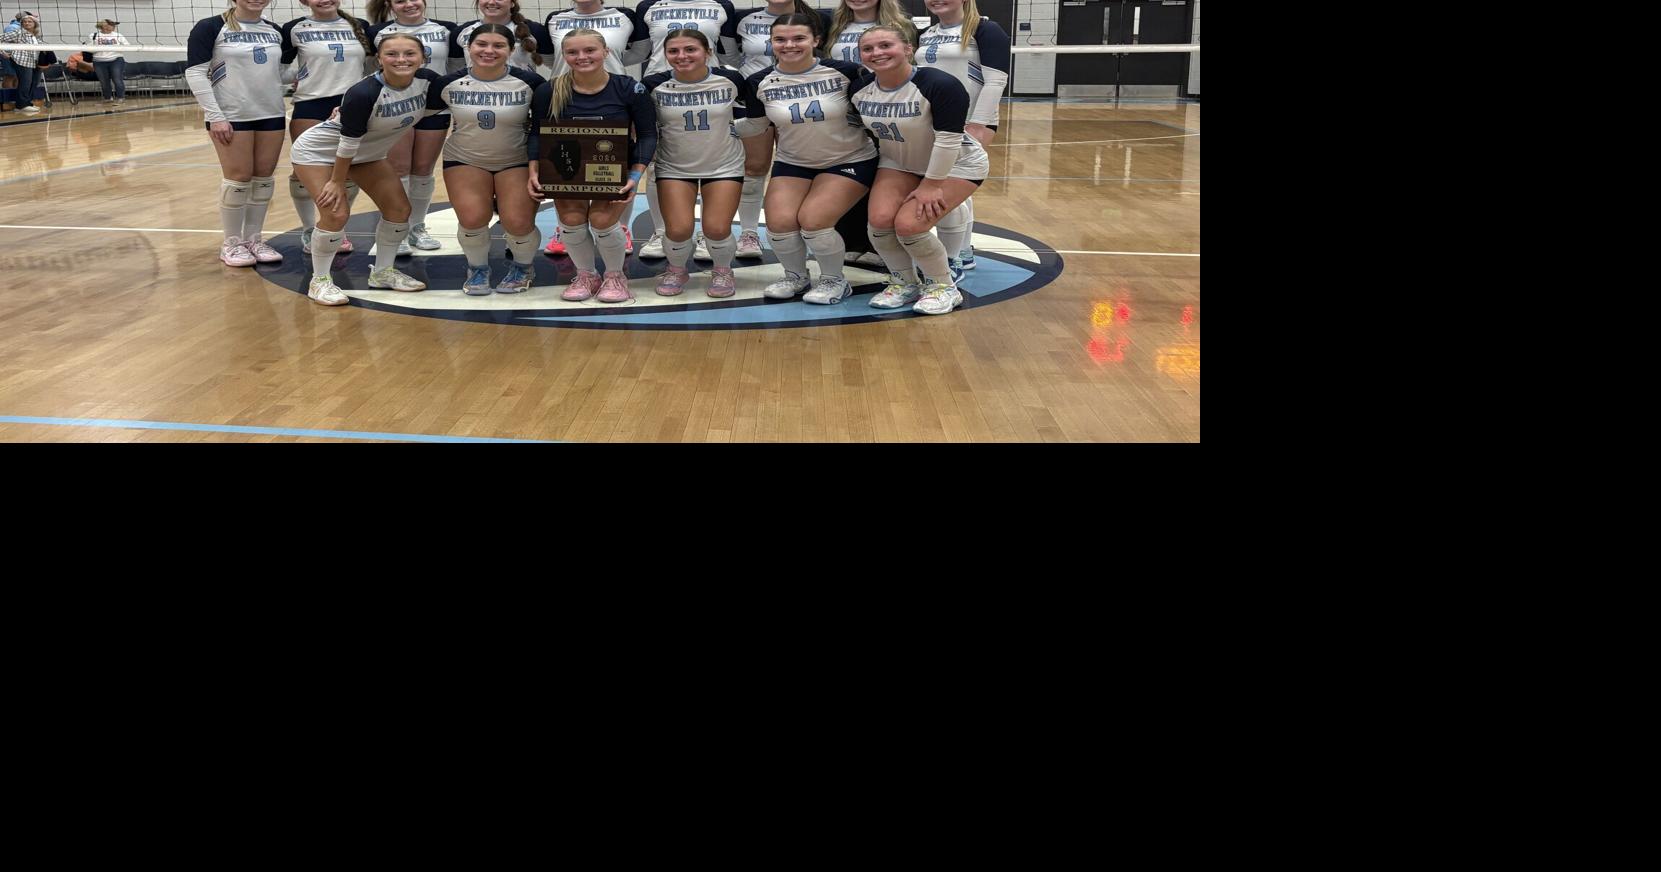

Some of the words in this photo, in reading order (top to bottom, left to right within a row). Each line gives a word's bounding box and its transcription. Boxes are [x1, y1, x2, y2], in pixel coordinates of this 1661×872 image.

[650, 8, 719, 21] PINCKNEYVILLE
[252, 46, 268, 64] 6
[328, 43, 344, 62] 7
[448, 90, 527, 106] PINCKNEYVILLE
[656, 88, 732, 106] PINCKNEYVILLE
[763, 78, 842, 100] PINCKNEYVILLE
[477, 109, 496, 130] 9
[682, 109, 710, 132] 11
[788, 99, 825, 124] 14
[871, 122, 904, 142] 21
